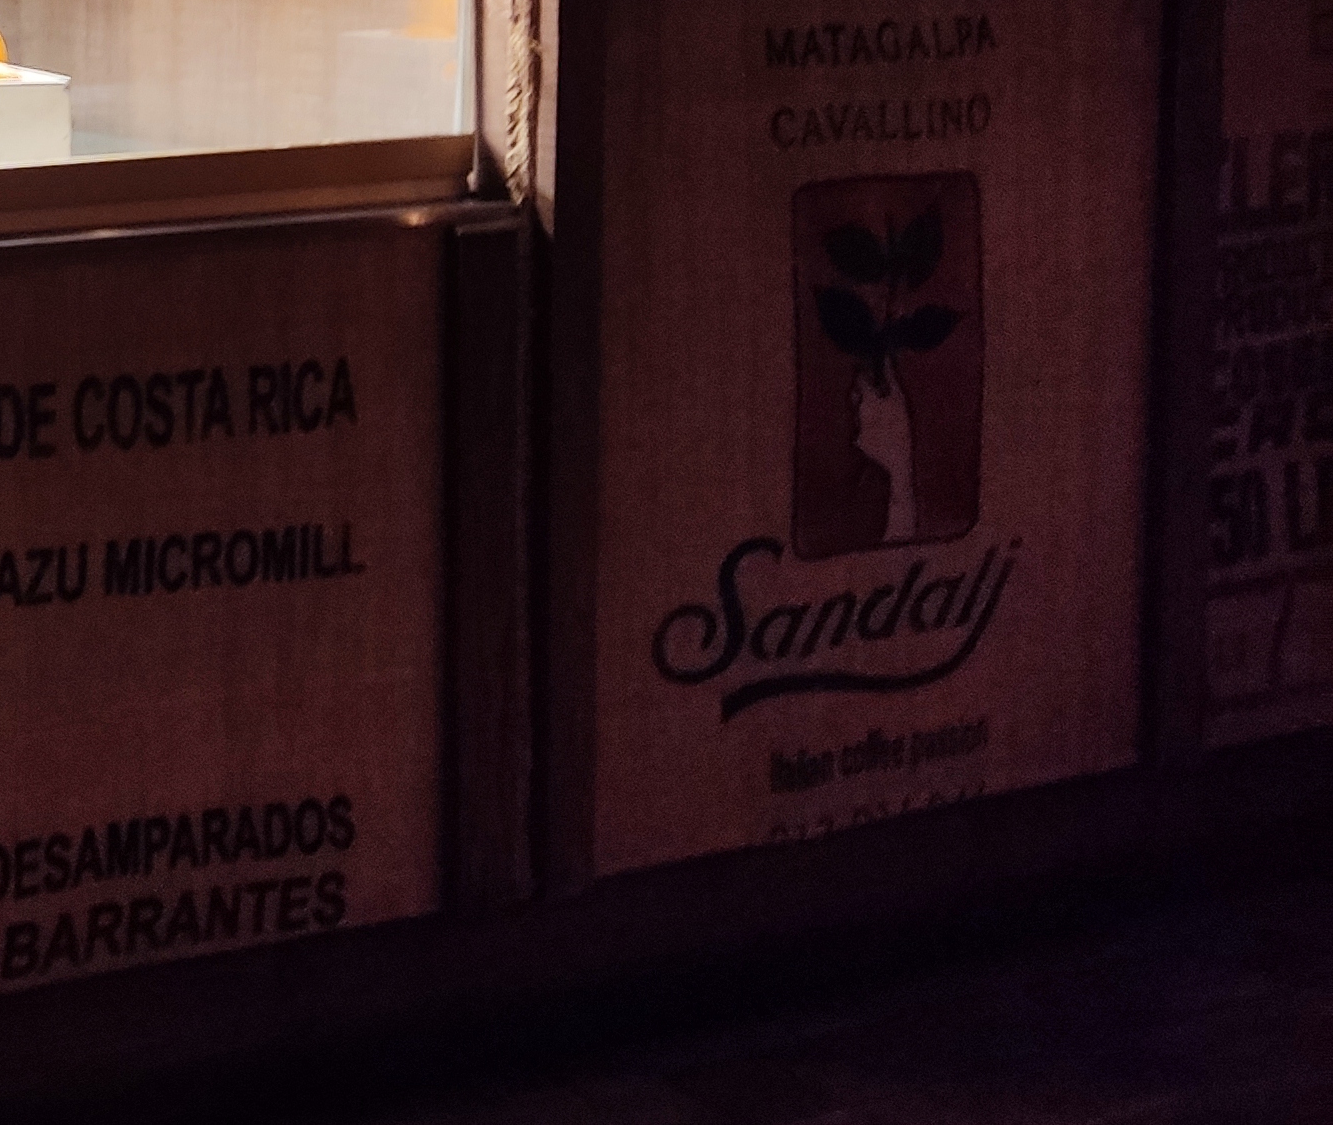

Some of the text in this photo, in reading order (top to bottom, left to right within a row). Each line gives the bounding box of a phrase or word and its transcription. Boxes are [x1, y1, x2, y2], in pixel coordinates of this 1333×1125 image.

[764, 15, 998, 68] MATAGALPA
[769, 94, 992, 149] CAVALLINO
[73, 367, 233, 452] COSTA
[248, 356, 357, 434] RICA
[104, 522, 367, 596] MICROMILL
[651, 536, 1023, 723] Sandalj
[0, 873, 345, 980] BARRANTES
